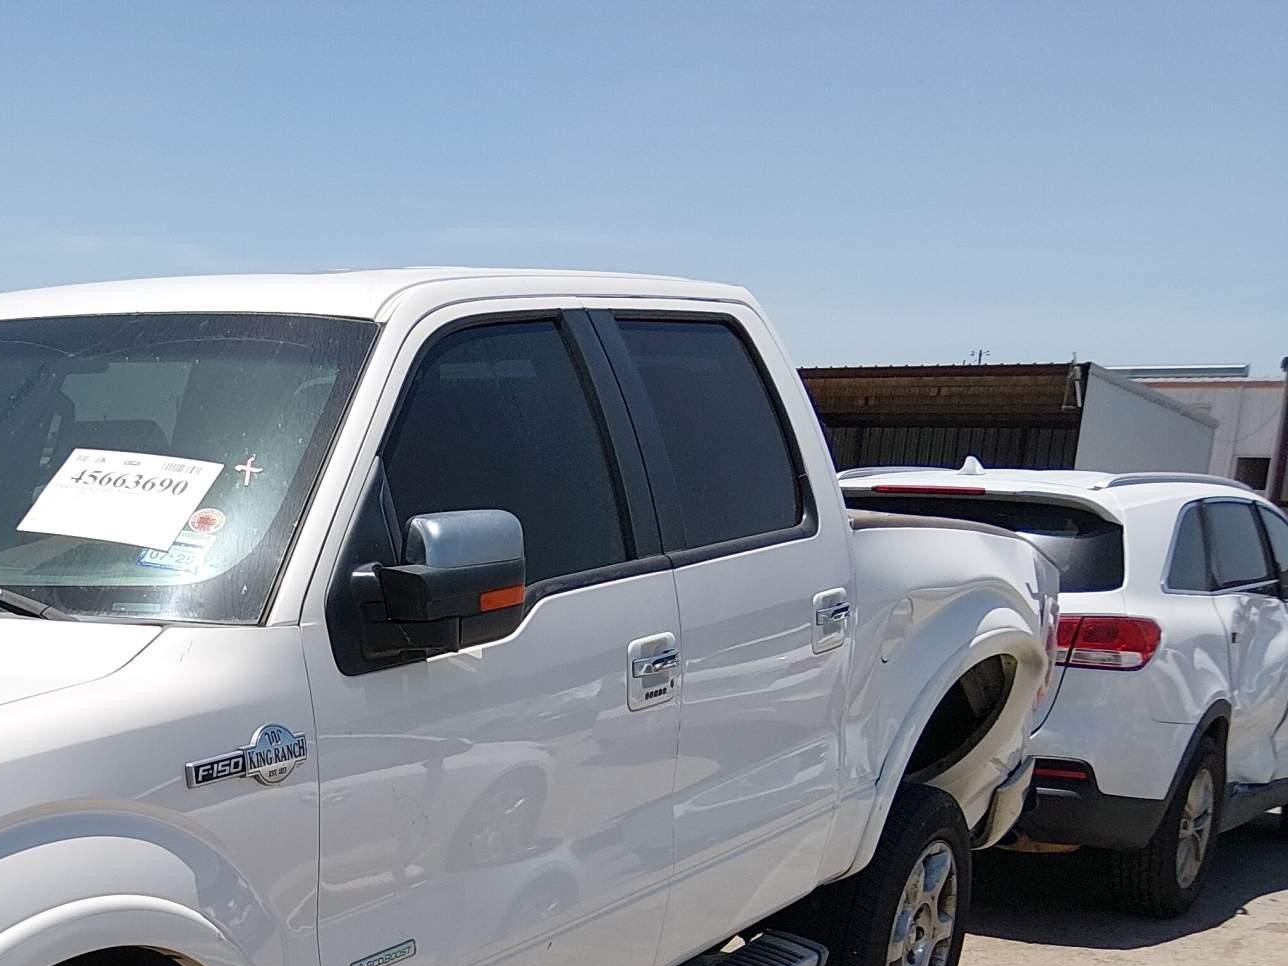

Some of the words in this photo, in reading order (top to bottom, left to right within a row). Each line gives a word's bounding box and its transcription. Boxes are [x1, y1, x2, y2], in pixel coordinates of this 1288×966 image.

[71, 468, 189, 496] 45663690
[274, 739, 306, 763] RANCH
[197, 756, 244, 782] F-150
